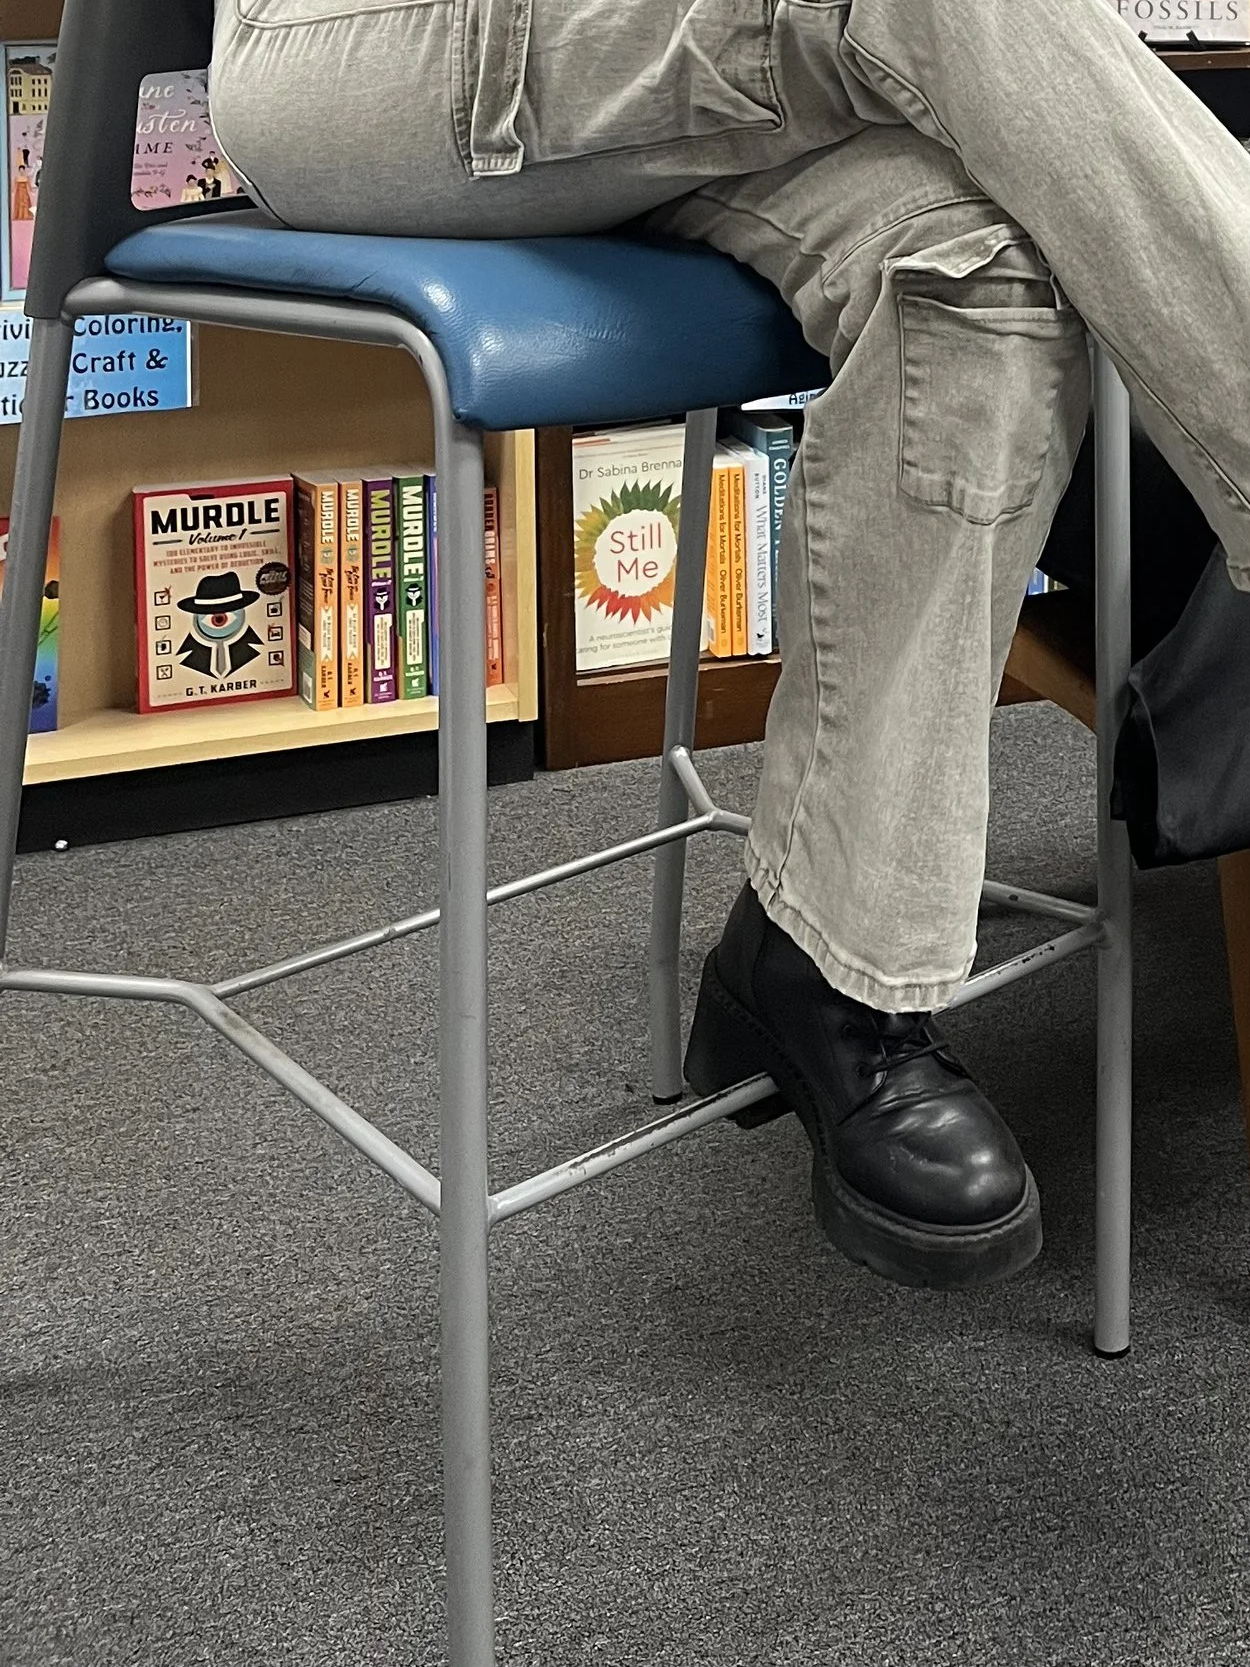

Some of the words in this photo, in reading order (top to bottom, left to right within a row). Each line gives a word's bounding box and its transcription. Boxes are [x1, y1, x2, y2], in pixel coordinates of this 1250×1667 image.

[1116, 0, 1239, 21] FOSSILS
[72, 350, 137, 374] Craft
[146, 348, 169, 370] &
[84, 386, 160, 411] Books
[578, 468, 594, 480] Dr
[597, 462, 638, 478] Sabina
[641, 459, 682, 473] Brenna
[718, 474, 727, 522] Meditations
[733, 474, 741, 518] Meditations
[151, 497, 281, 535] MURDLE
[320, 490, 334, 545] MURDLE
[346, 488, 359, 543] MURDLE
[756, 505, 767, 540] What
[188, 532, 237, 546] Volume
[238, 528, 248, 540] 1
[609, 521, 662, 554] Still
[734, 530, 742, 564] Mortals
[617, 556, 659, 584] Me
[756, 543, 767, 589] Matters
[757, 591, 768, 622] Most
[599, 642, 611, 651] for
[612, 639, 648, 650] someone
[210, 678, 257, 694] KARBER
